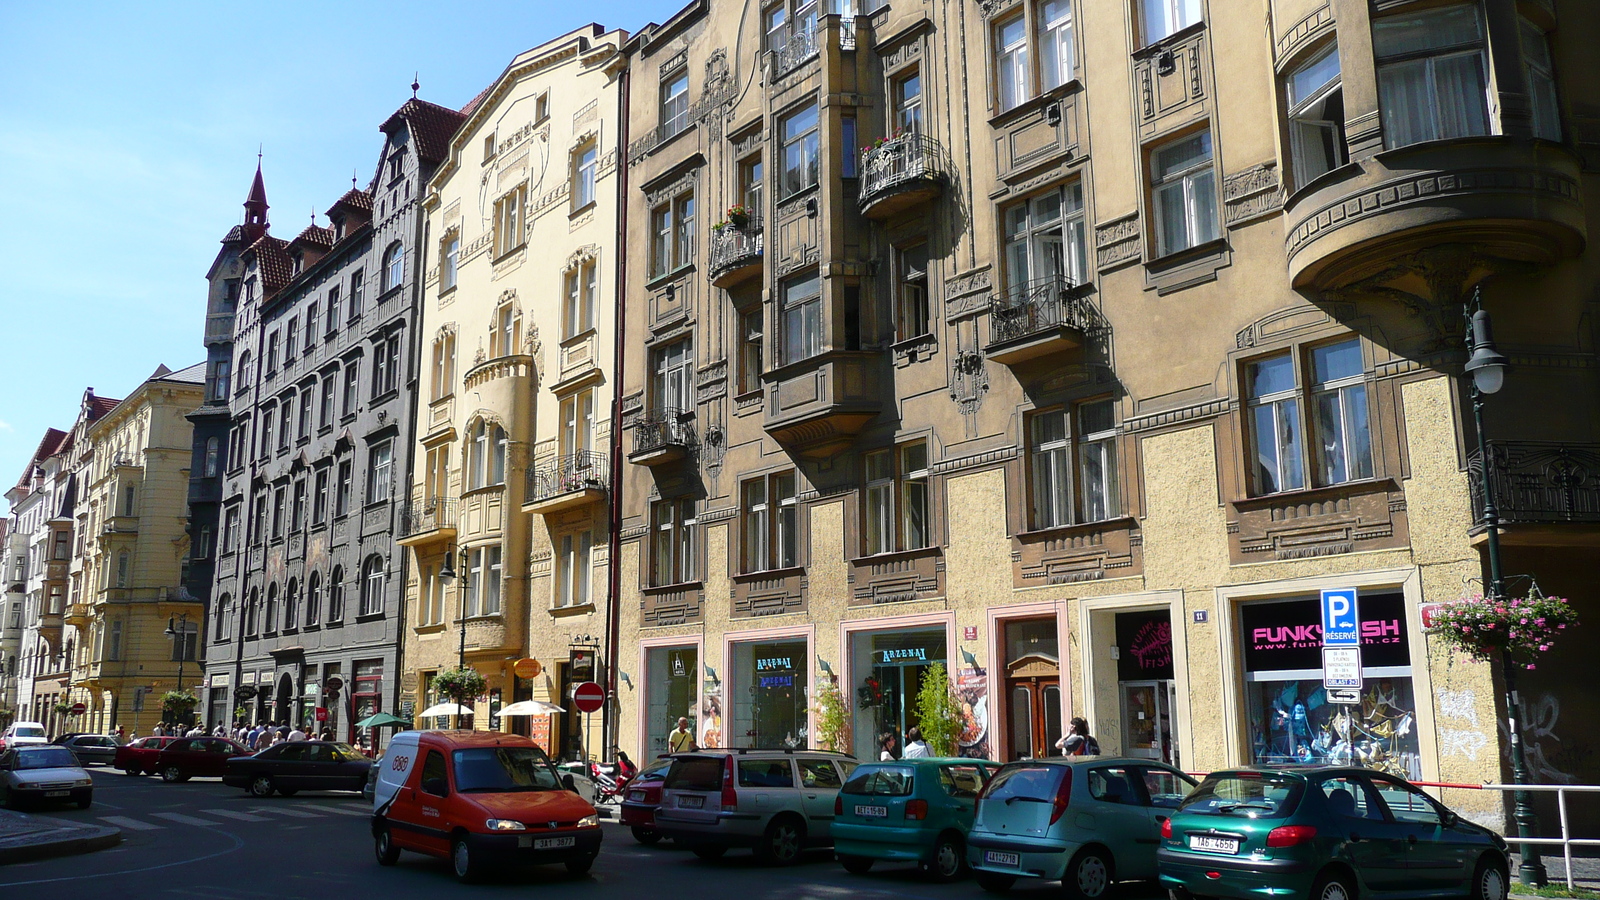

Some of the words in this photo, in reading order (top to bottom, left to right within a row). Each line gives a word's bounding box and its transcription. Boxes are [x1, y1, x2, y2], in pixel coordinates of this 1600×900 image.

[1196, 612, 1203, 620] 11
[1328, 595, 1350, 628] P
[1253, 619, 1400, 643] FUNKSH
[1325, 630, 1357, 640] RÉSERVÉ
[883, 648, 927, 662] ARZENAL
[1145, 654, 1171, 669] FISH
[757, 657, 792, 670] ARZENAL
[760, 676, 792, 687] ARZENAL
[1197, 837, 1209, 847] 1A6
[1215, 840, 1234, 850] 4656
